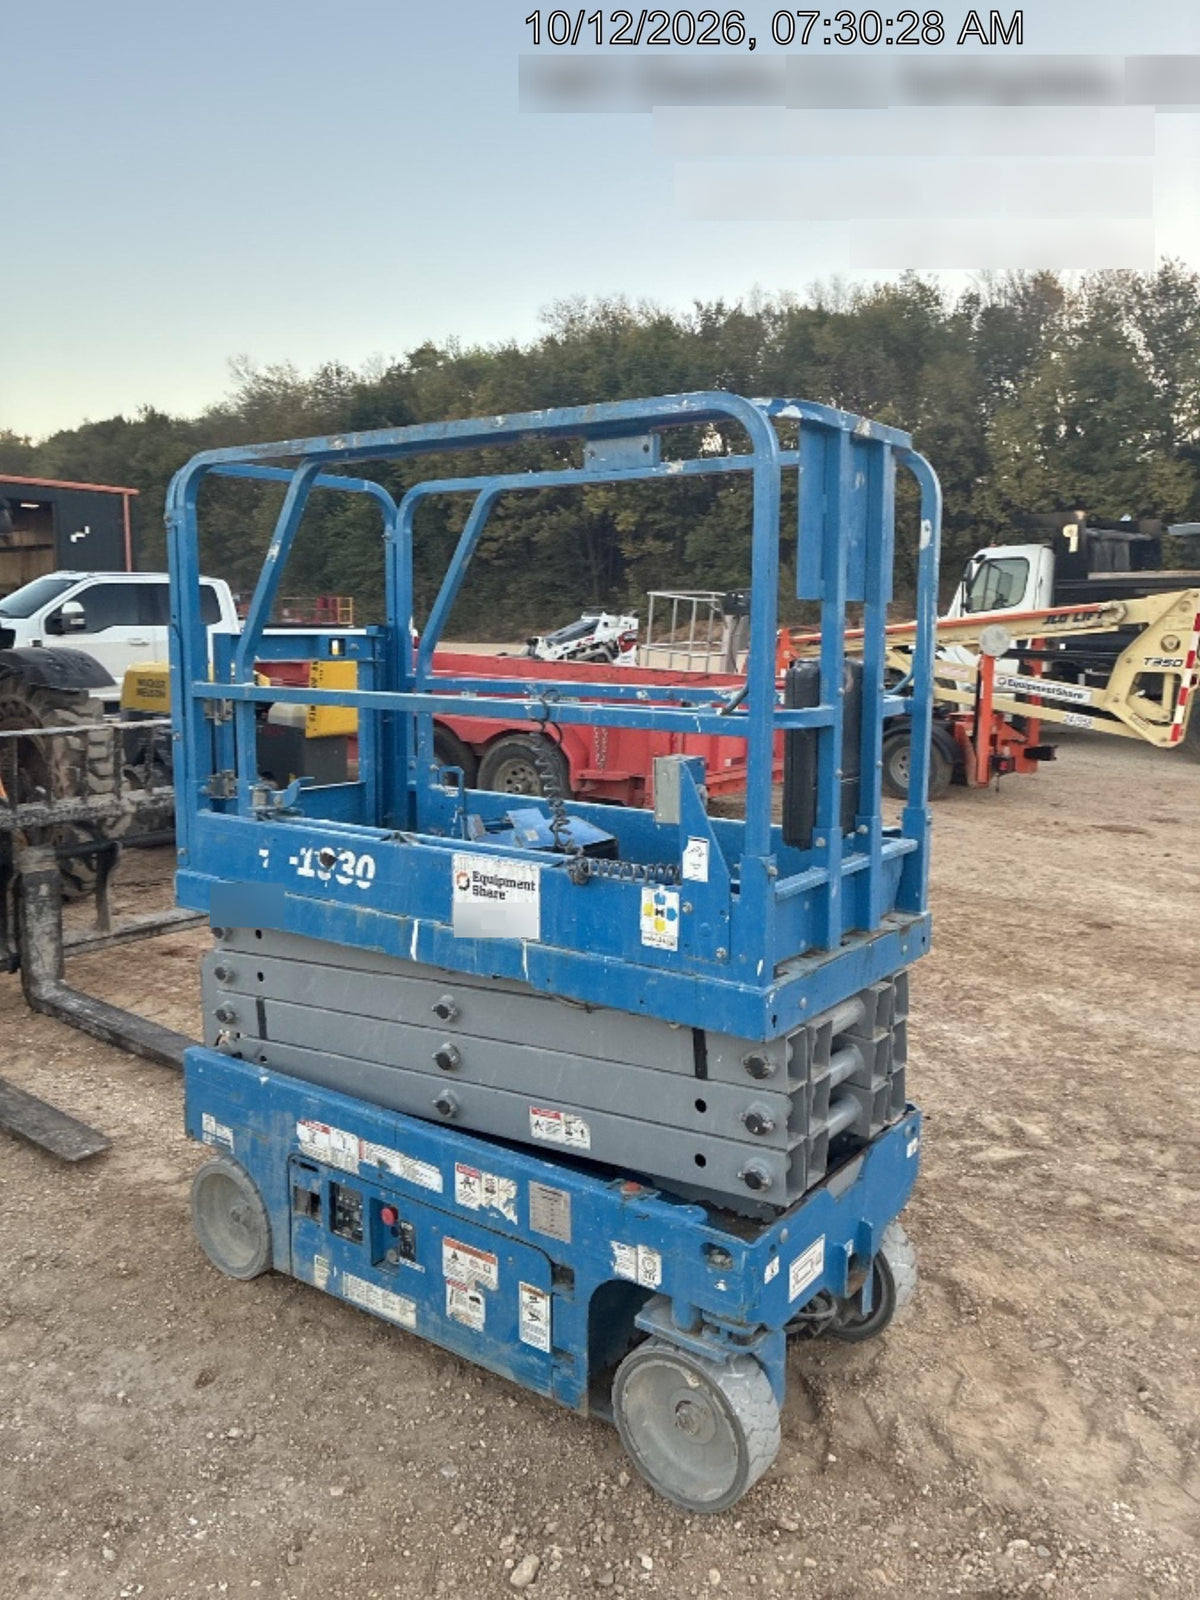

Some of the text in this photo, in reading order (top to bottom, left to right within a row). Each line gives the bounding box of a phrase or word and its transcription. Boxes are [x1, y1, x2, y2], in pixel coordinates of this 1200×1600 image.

[1144, 657, 1184, 667] T350
[472, 870, 536, 891] Equipment
[472, 885, 506, 900] Share
